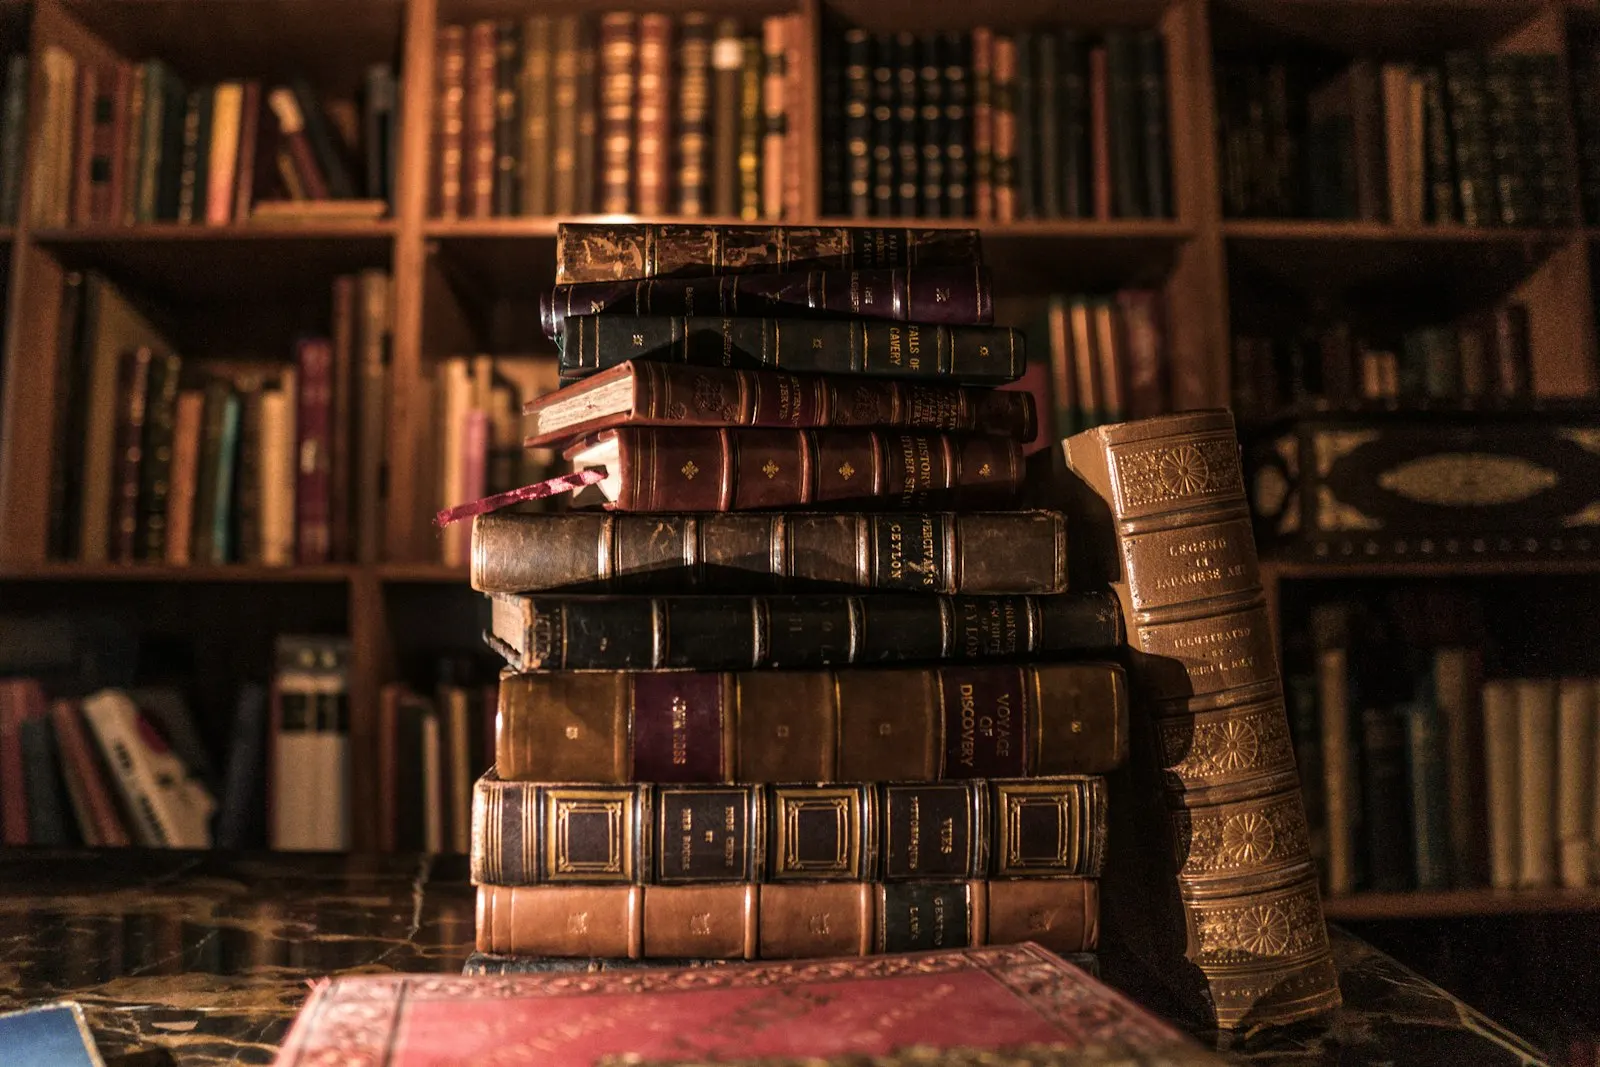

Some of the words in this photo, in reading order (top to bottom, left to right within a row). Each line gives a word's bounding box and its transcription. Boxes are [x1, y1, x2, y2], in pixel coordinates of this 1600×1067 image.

[889, 327, 901, 367] CAVERY
[908, 325, 920, 354] FALLS
[909, 358, 920, 371] OF
[916, 437, 931, 488] HISTORY
[891, 524, 902, 580] CEYLON
[1169, 538, 1227, 556] LEGEND
[1156, 568, 1222, 589] JAPANESE
[1174, 627, 1251, 649] ILLUSTRATED
[959, 683, 975, 767] DISCOVERY
[979, 715, 994, 737] OF
[996, 693, 1011, 757] VOYAGE
[672, 733, 687, 765] ROSS
[940, 817, 953, 855] VUES
[934, 896, 944, 946] GENTOO
